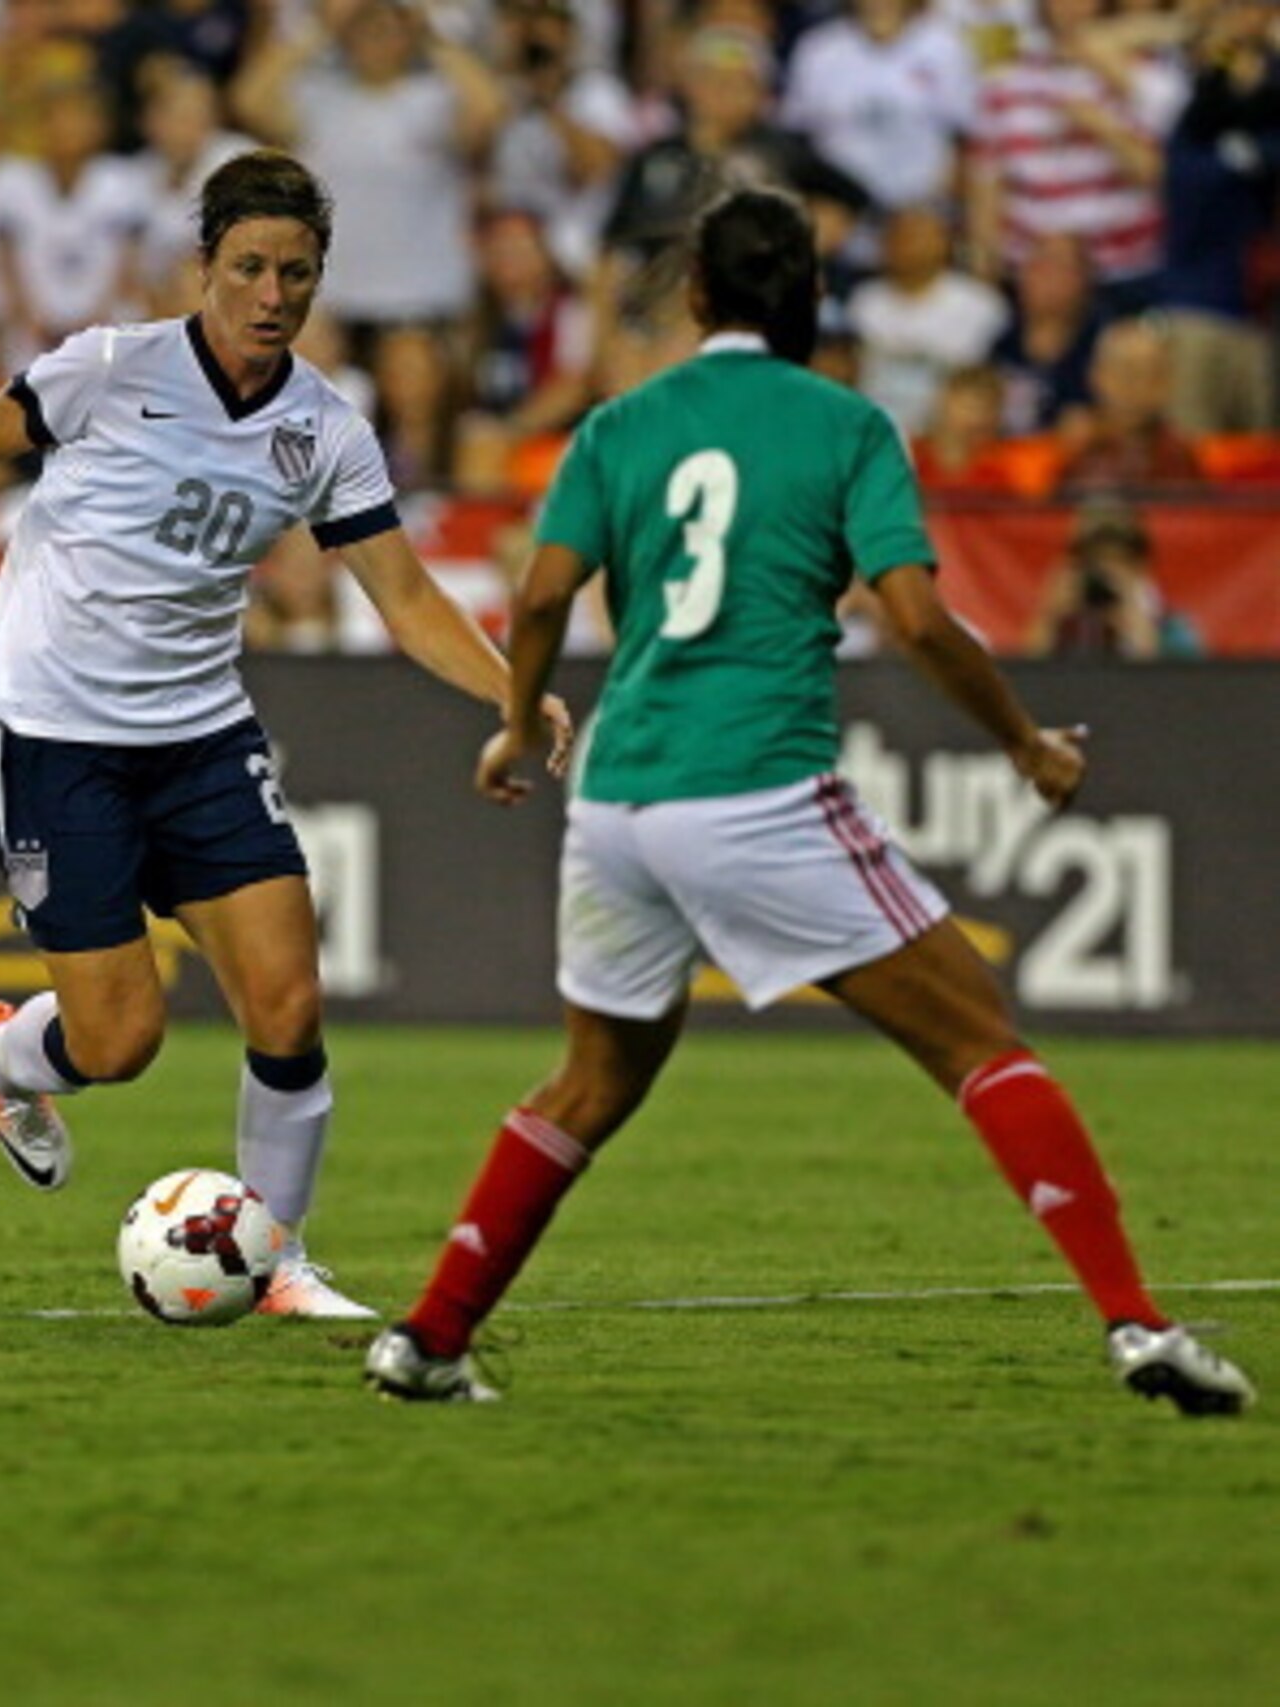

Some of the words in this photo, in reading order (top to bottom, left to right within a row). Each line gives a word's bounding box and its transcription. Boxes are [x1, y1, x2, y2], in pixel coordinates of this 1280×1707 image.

[154, 478, 254, 567] 20
[658, 448, 739, 638] 3
[1018, 812, 1174, 1008] 21
